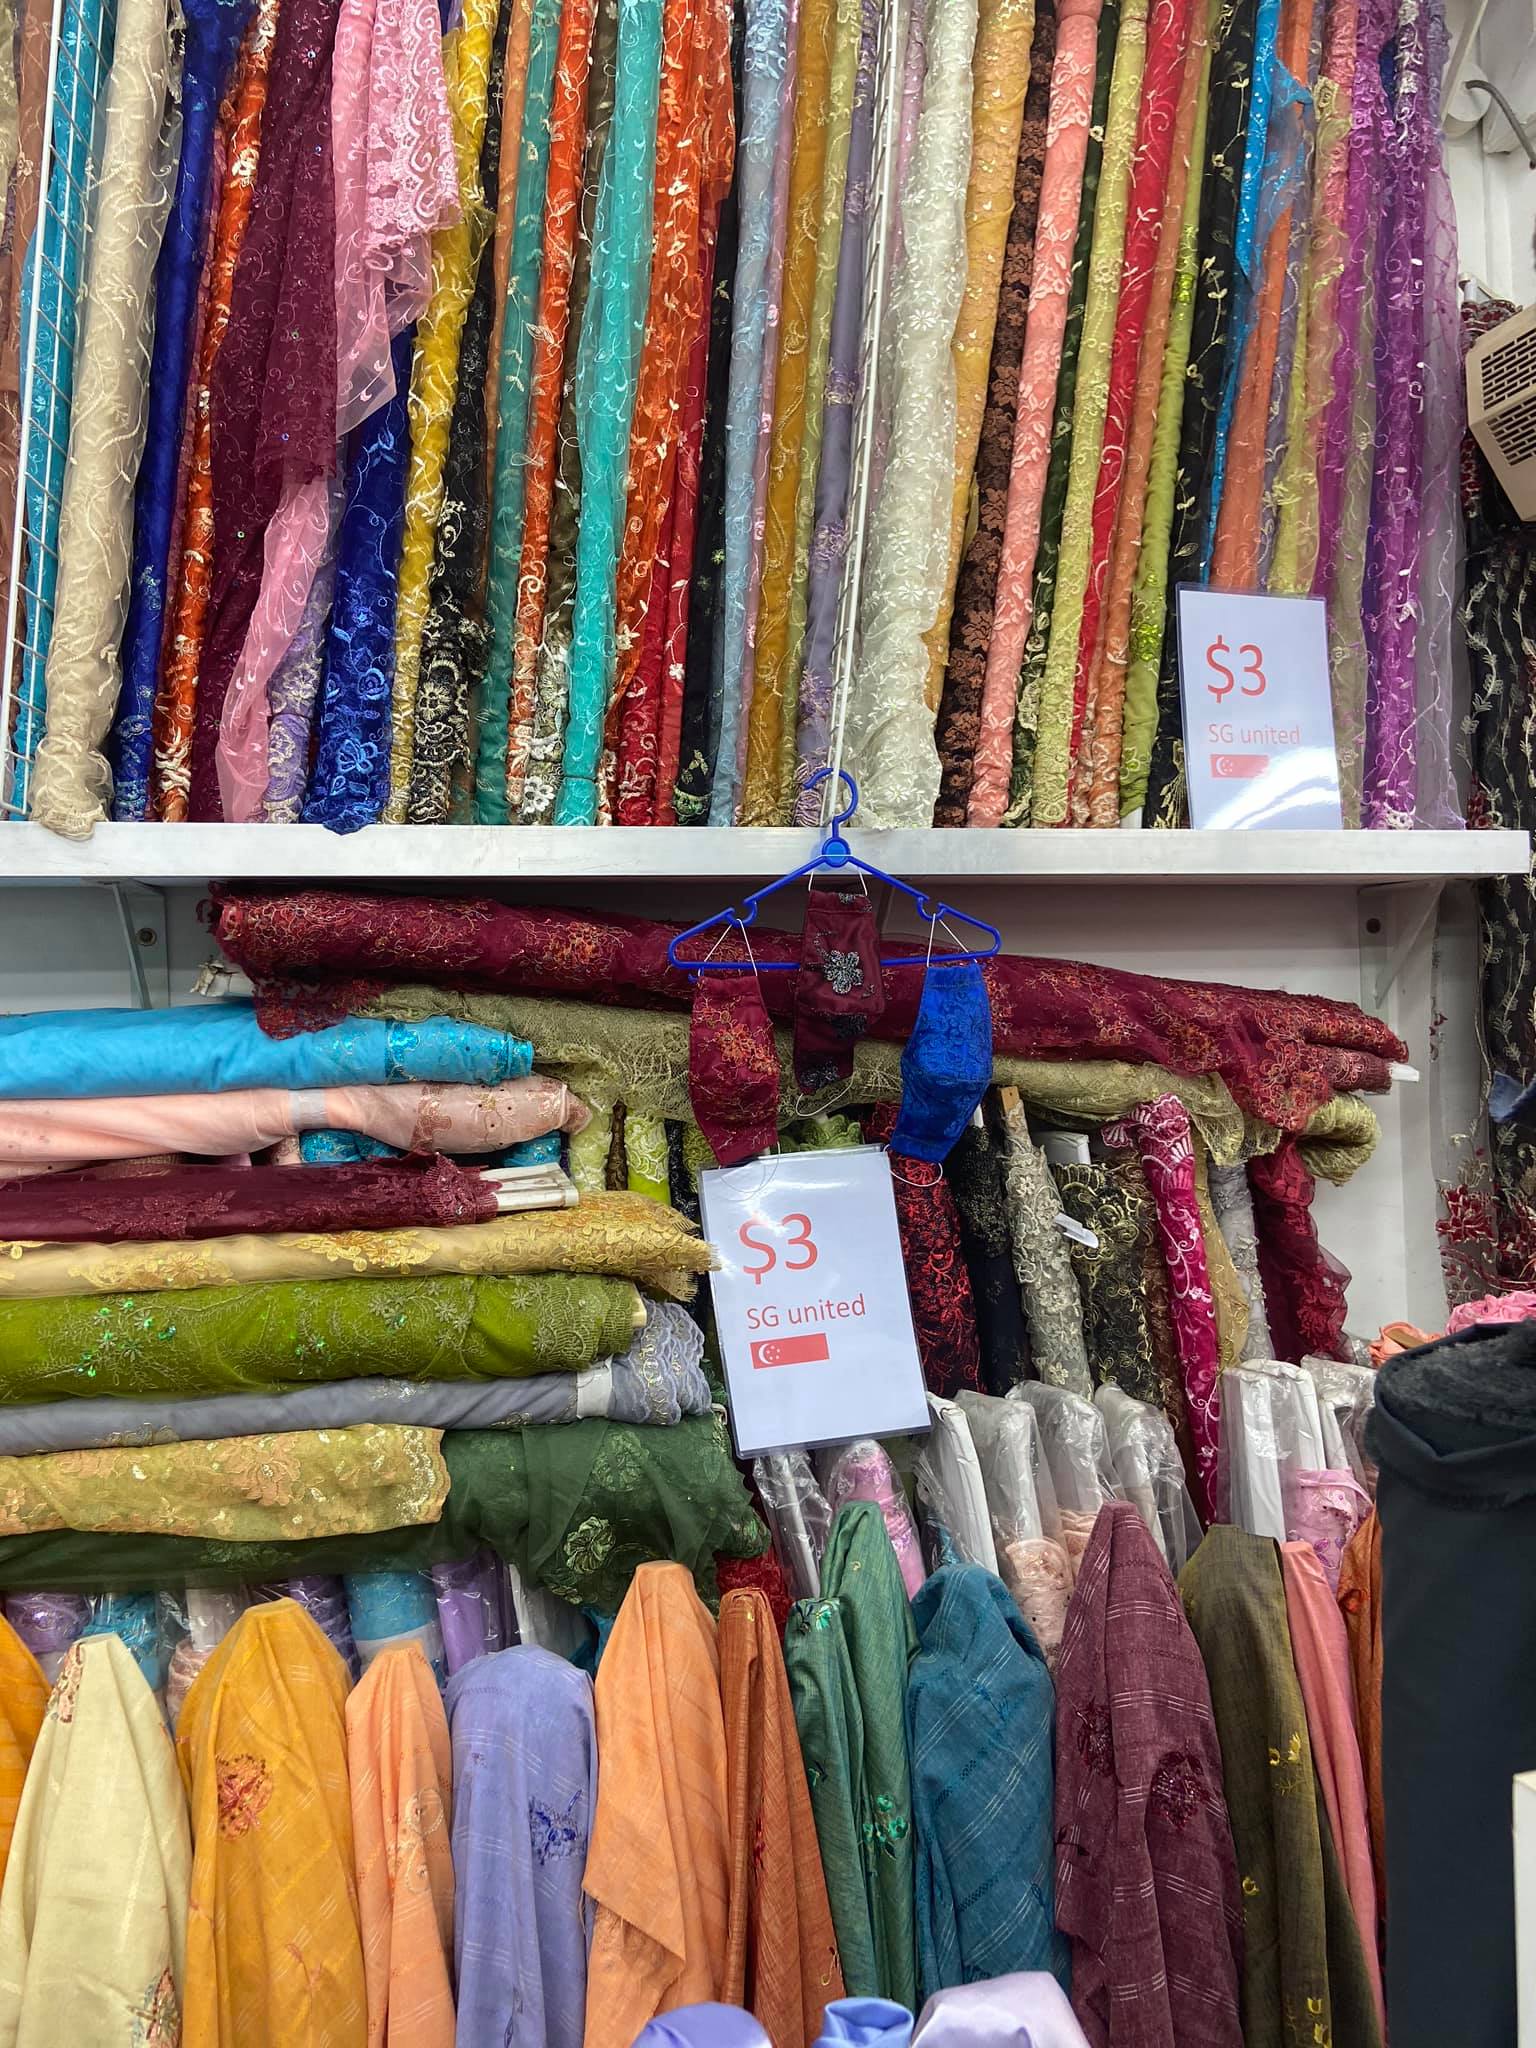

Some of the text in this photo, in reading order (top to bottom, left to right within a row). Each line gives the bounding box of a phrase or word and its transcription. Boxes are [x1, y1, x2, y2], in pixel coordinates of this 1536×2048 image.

[1206, 634, 1266, 703] $3
[1208, 723, 1301, 745] SG united
[738, 1212, 818, 1285] $3
[747, 1293, 866, 1329] SG united
